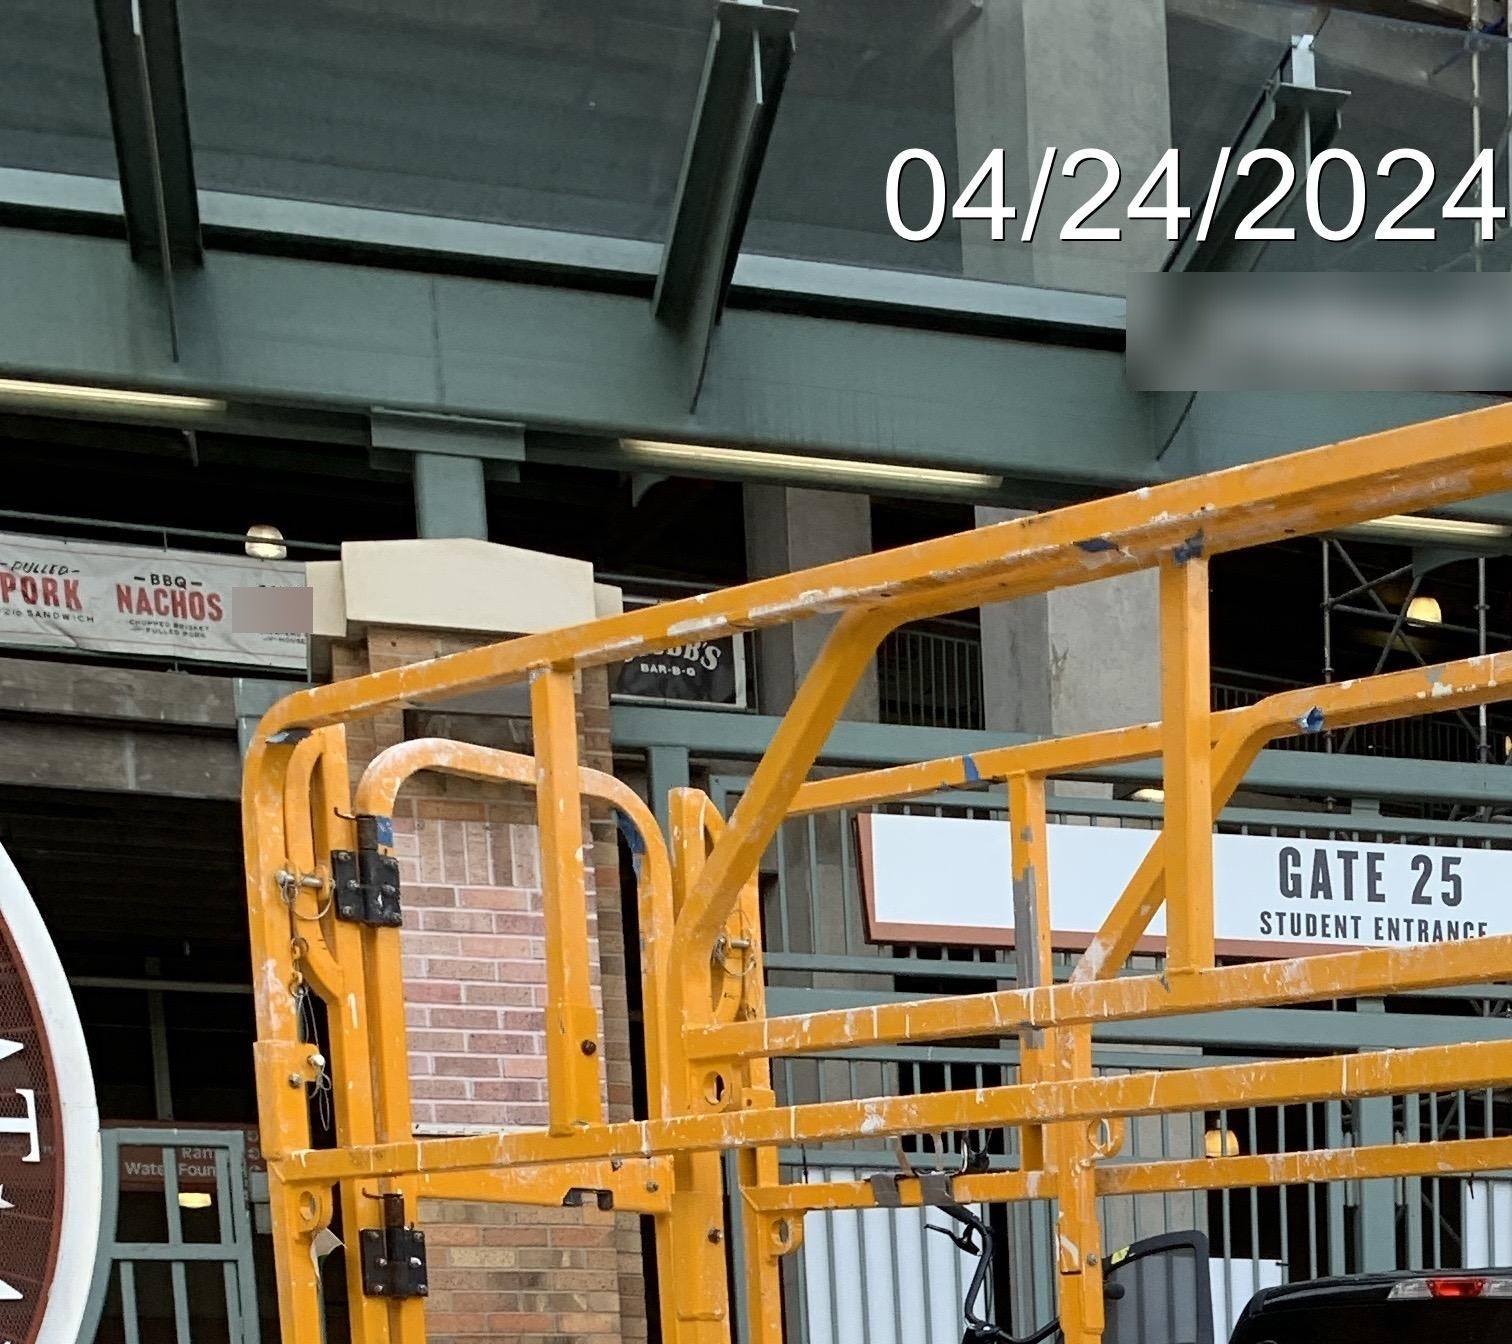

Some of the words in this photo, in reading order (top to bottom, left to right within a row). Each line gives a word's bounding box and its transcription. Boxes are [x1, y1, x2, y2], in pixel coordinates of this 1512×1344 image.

[11, 561, 69, 576] PULLED
[150, 573, 187, 589] BBQ
[0, 571, 83, 612] PORK
[115, 583, 224, 622] NACHOS
[27, 609, 95, 623] SANDWICH
[1278, 846, 1386, 903] GATE
[1410, 854, 1463, 907] 25
[1259, 911, 1362, 939] STUDENT
[1374, 917, 1488, 943] ENTRANCE
